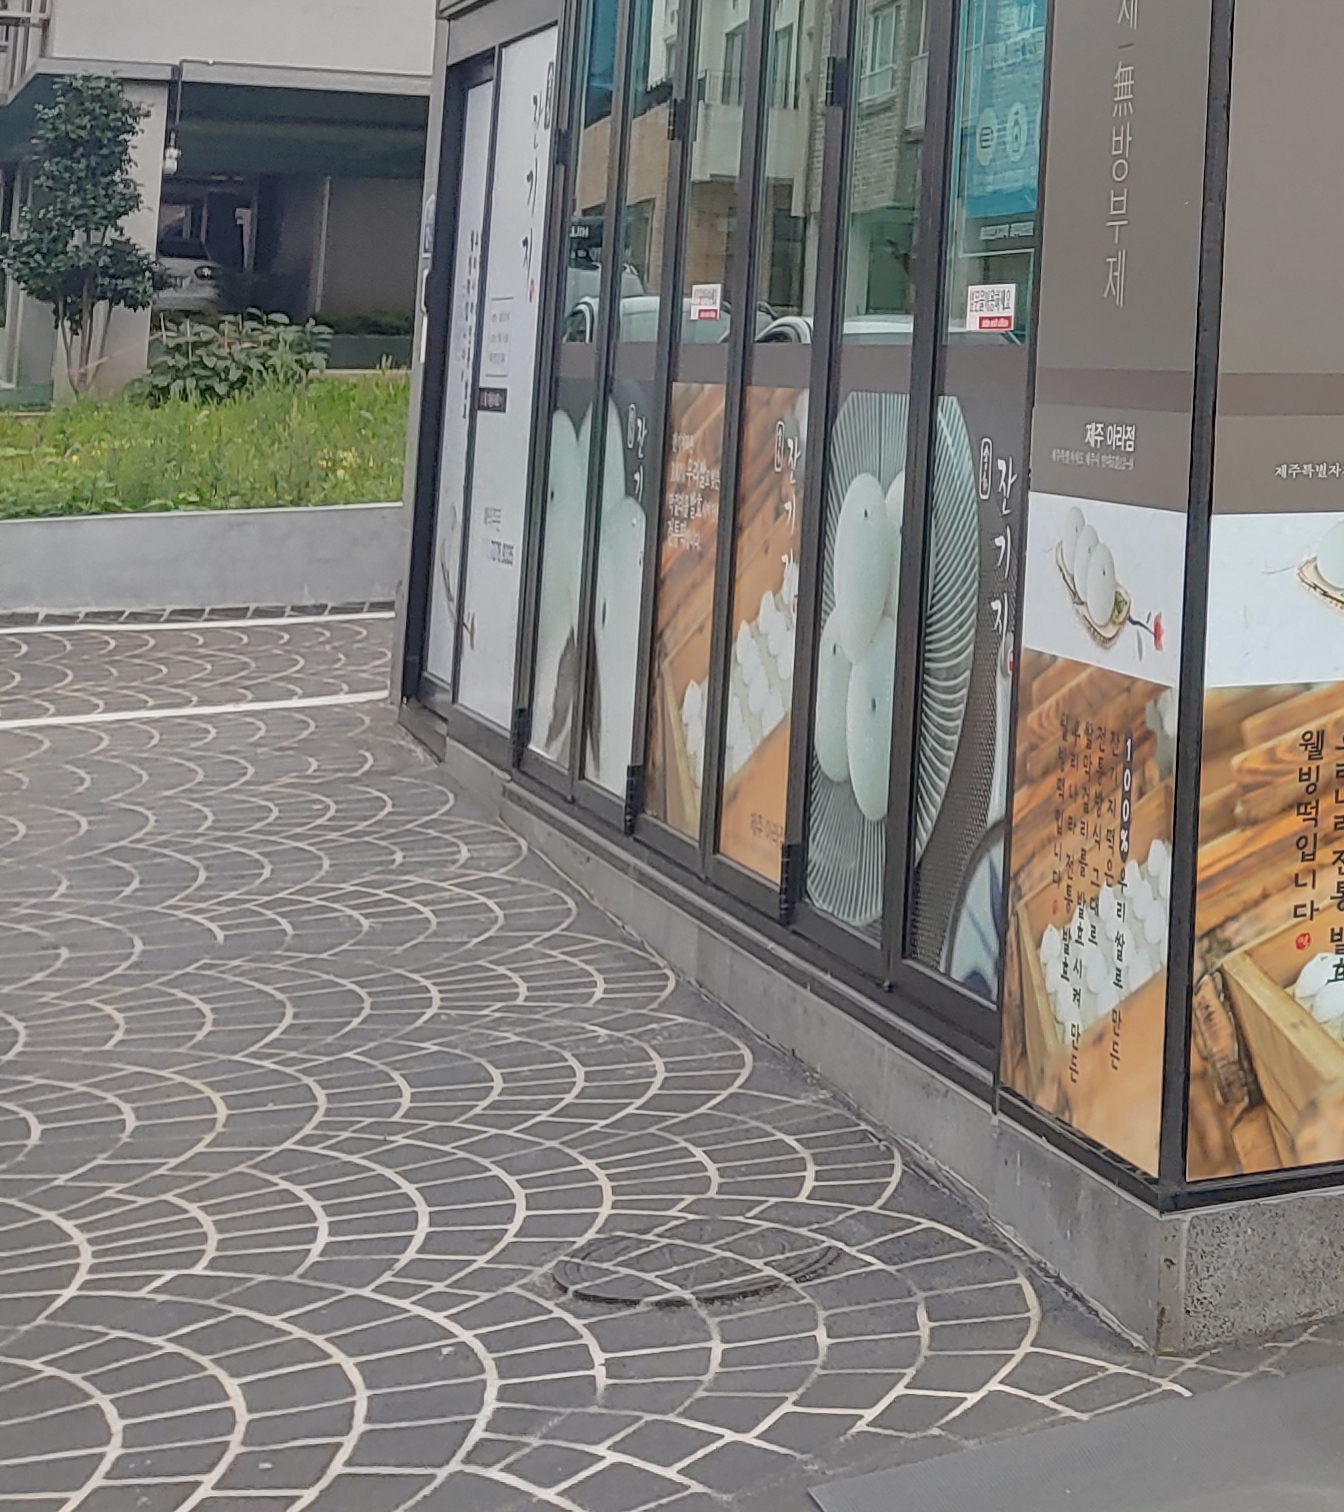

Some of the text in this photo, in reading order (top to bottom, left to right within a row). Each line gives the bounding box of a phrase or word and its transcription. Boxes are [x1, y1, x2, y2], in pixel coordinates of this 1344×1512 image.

[1102, 60, 1135, 308] 無방부제
[1085, 422, 1136, 451] 제주 아라점
[990, 456, 1018, 660] 잔기지
[1119, 738, 1132, 854] 100%
[1292, 728, 1325, 921] 웰빙떡입니다
